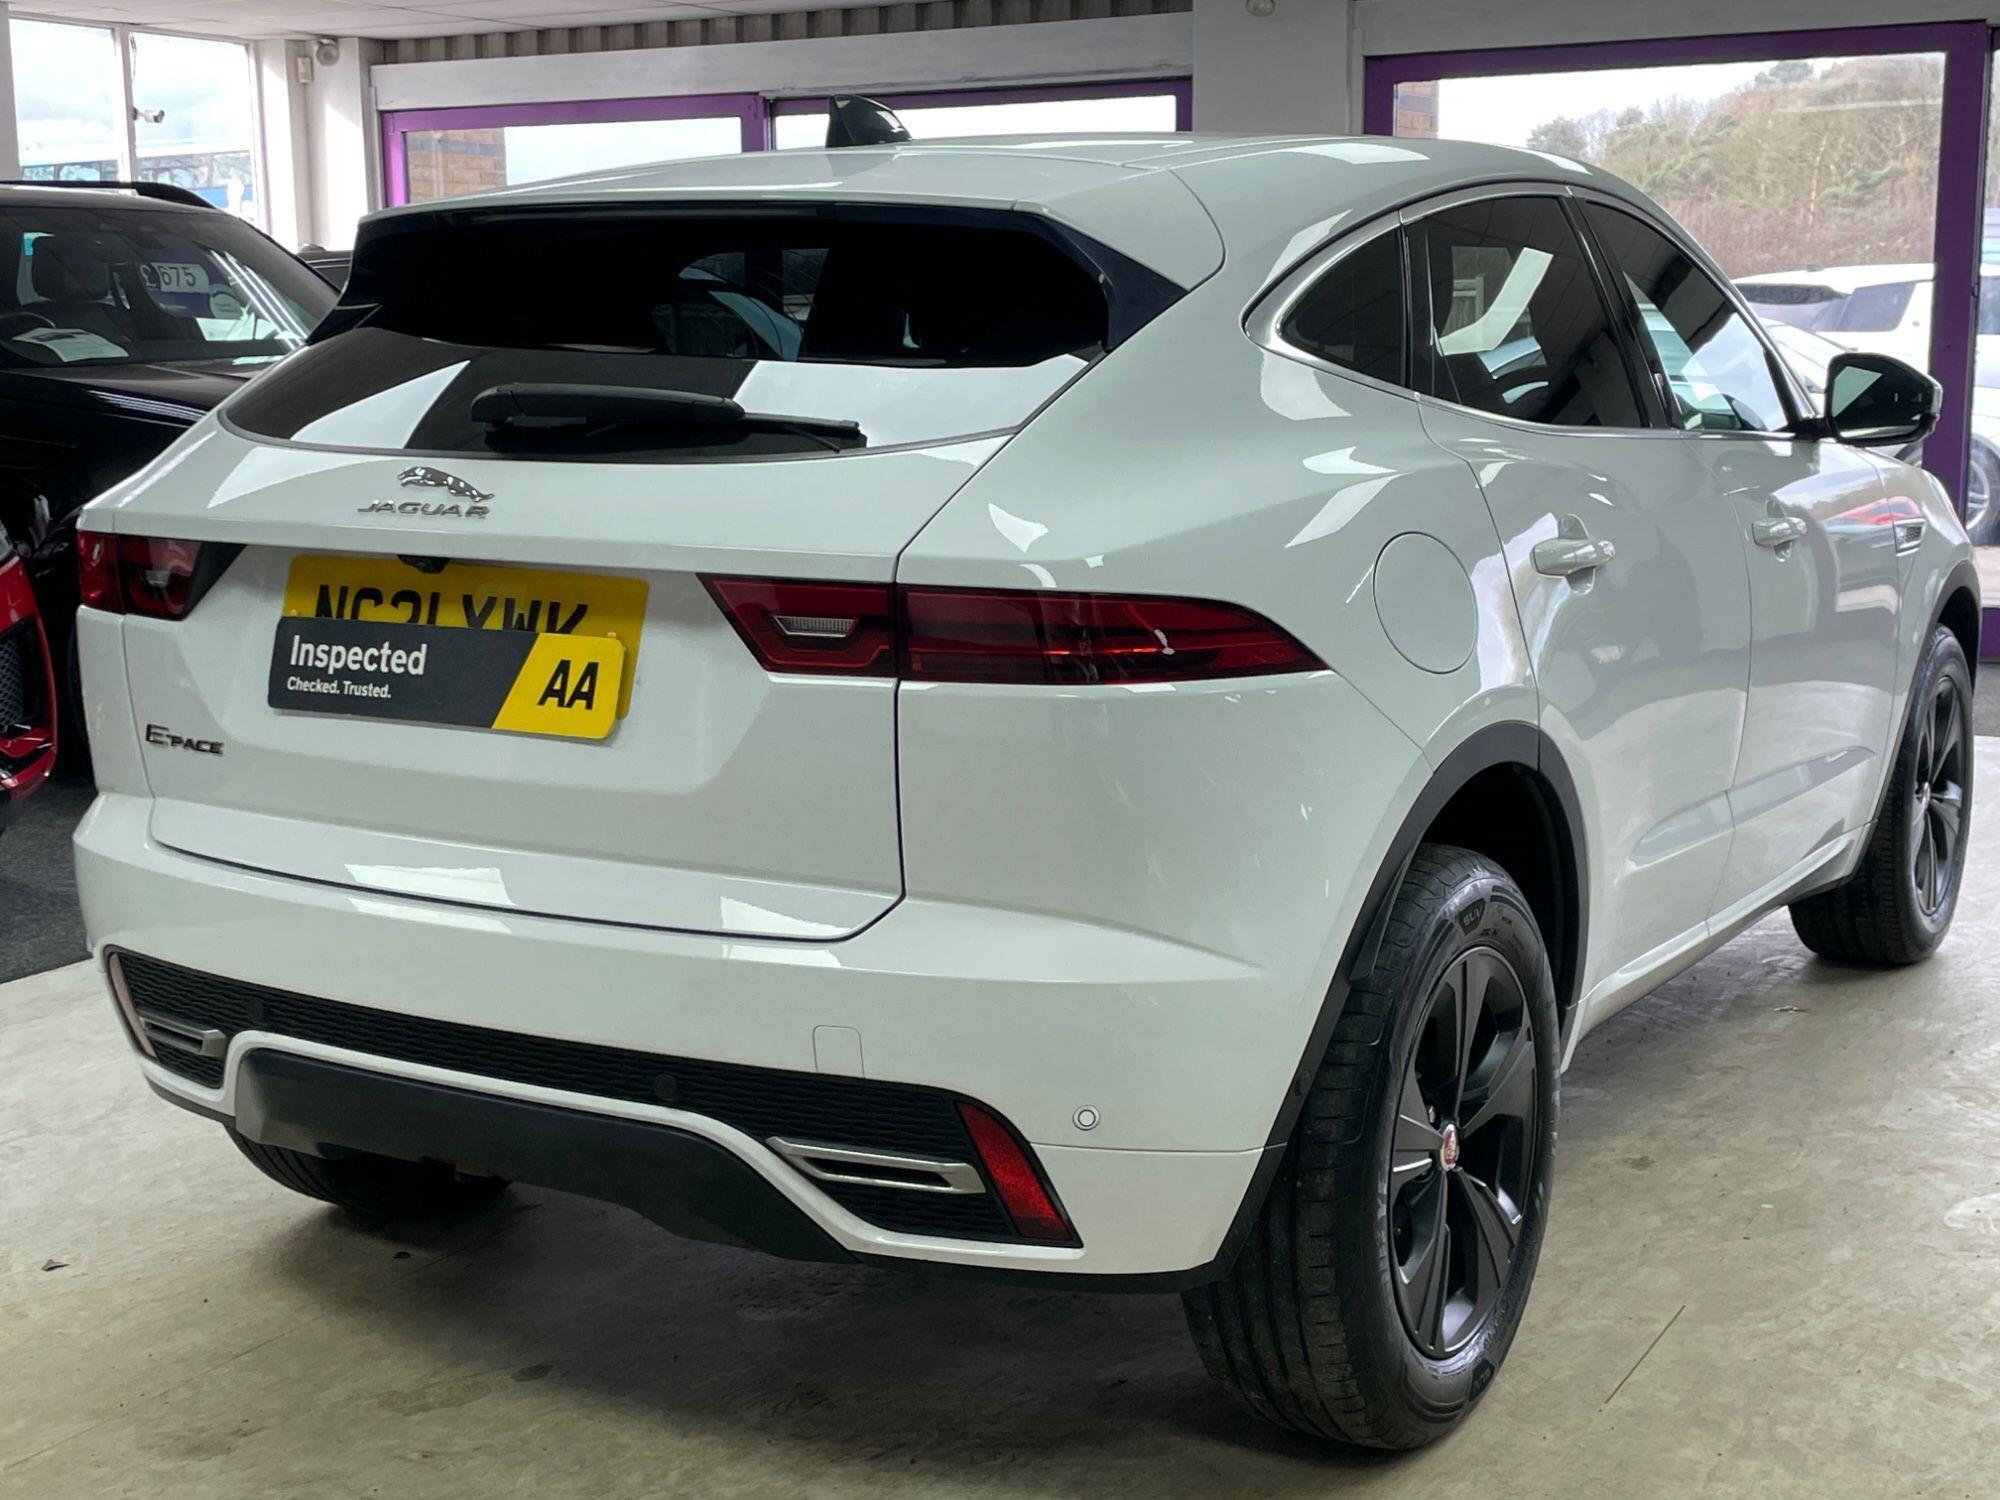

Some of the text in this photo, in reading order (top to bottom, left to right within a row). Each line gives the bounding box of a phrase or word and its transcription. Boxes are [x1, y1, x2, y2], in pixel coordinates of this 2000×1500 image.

[357, 499, 491, 519] JAGUAR
[289, 635, 428, 676] Inspected
[286, 676, 392, 699] Checked. Trusted.
[537, 659, 599, 711] AA
